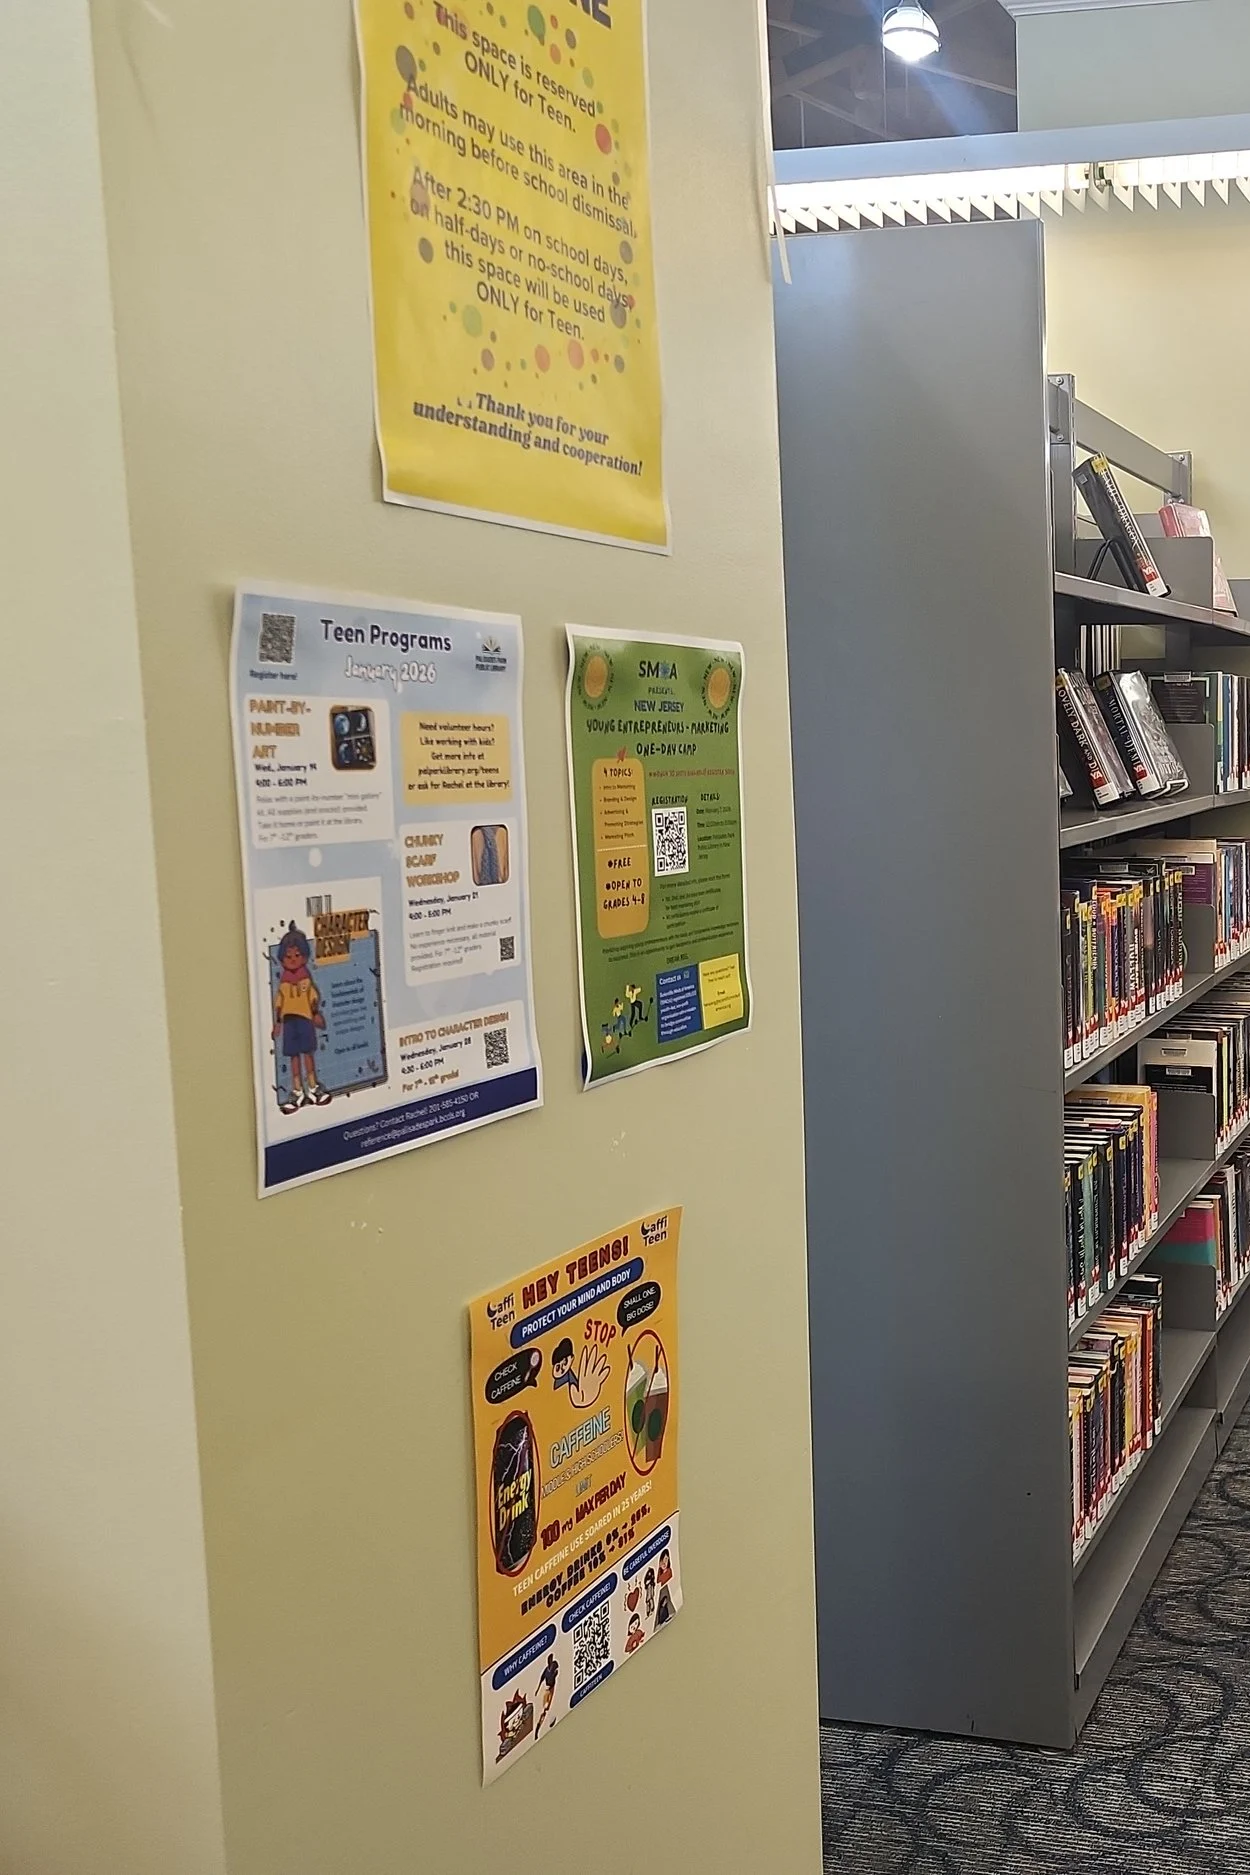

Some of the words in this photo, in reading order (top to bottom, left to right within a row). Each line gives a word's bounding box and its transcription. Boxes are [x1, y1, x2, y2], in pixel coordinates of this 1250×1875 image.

[433, 1, 467, 40] This
[472, 28, 516, 69] space
[521, 55, 532, 80] is
[536, 65, 596, 118] reserved
[465, 51, 511, 92] ONLY
[514, 79, 534, 106] for
[538, 96, 577, 133] Teen.
[400, 104, 466, 158] morning
[471, 137, 519, 181] before
[523, 170, 568, 204] school
[407, 74, 458, 120] Adults
[462, 109, 495, 142] may
[499, 131, 524, 156] use
[529, 143, 554, 171] this
[558, 164, 588, 190] area
[592, 174, 604, 199] in
[608, 185, 629, 211] the
[410, 199, 430, 217] on
[434, 203, 506, 256] half-days
[509, 240, 523, 260] or
[528, 250, 594, 294] no-school
[412, 166, 452, 201] After
[457, 187, 491, 220] 2:30
[496, 206, 520, 235] PM
[524, 222, 542, 246] on
[546, 231, 590, 267] school
[593, 254, 628, 285] days,
[444, 239, 473, 269] this
[478, 256, 521, 288] space
[525, 277, 549, 300] will
[553, 286, 569, 309] be
[573, 298, 605, 323] used
[476, 281, 520, 315] ONLY
[524, 299, 544, 325] for
[547, 309, 585, 341] Teen.
[413, 401, 531, 449] understanding
[534, 433, 560, 453] and
[562, 443, 643, 476] cooperation!
[475, 392, 526, 422] Thank
[528, 410, 553, 430] you
[556, 415, 577, 437] for
[579, 426, 609, 447] your
[320, 619, 365, 643] Teen
[370, 625, 452, 653] Programs
[345, 655, 400, 693] January
[401, 662, 437, 684] 2026
[586, 719, 616, 734] YOUNG
[617, 719, 685, 736] ENTREPRENEURS
[690, 722, 729, 736] MARKETING
[634, 700, 656, 713] NEW
[658, 701, 685, 713] JERSEY
[636, 743, 676, 758] ONE-DAY
[678, 743, 698, 757] CAMP
[611, 879, 631, 892] OPEN
[632, 878, 643, 888] TO
[613, 857, 632, 869] FREE
[603, 898, 630, 911] GRADES
[632, 893, 646, 907] 4-8
[522, 1270, 560, 1310] HEY
[566, 1235, 629, 1285] TEENS!
[522, 1309, 557, 1338] PROTECT
[557, 1298, 577, 1318] YOUR
[577, 1288, 596, 1307] MIND
[596, 1280, 611, 1296] AND
[611, 1268, 631, 1286] BODY
[623, 1293, 642, 1309] SMALL
[642, 1287, 657, 1299] ONE
[626, 1310, 637, 1322] BIG
[584, 1318, 617, 1348] STOP
[490, 1375, 523, 1400] CAFFEINE
[494, 1361, 518, 1382] CHECK
[550, 1406, 612, 1470] CAFFEINE
[575, 1496, 595, 1524] MAX
[595, 1483, 611, 1509] PER
[610, 1471, 627, 1497] DAY
[512, 1578, 534, 1597] TEEN
[534, 1545, 570, 1581] CAFFEINE
[570, 1535, 585, 1552] USE
[585, 1513, 613, 1541] SOARED
[612, 1505, 621, 1519] IN
[621, 1498, 630, 1512] 25
[629, 1479, 653, 1505] YEARS!
[568, 1605, 588, 1623] CHECK
[586, 1582, 612, 1611] CAFFEINE!
[503, 1659, 518, 1678] WHY
[517, 1635, 548, 1667] CAFFEINE?
